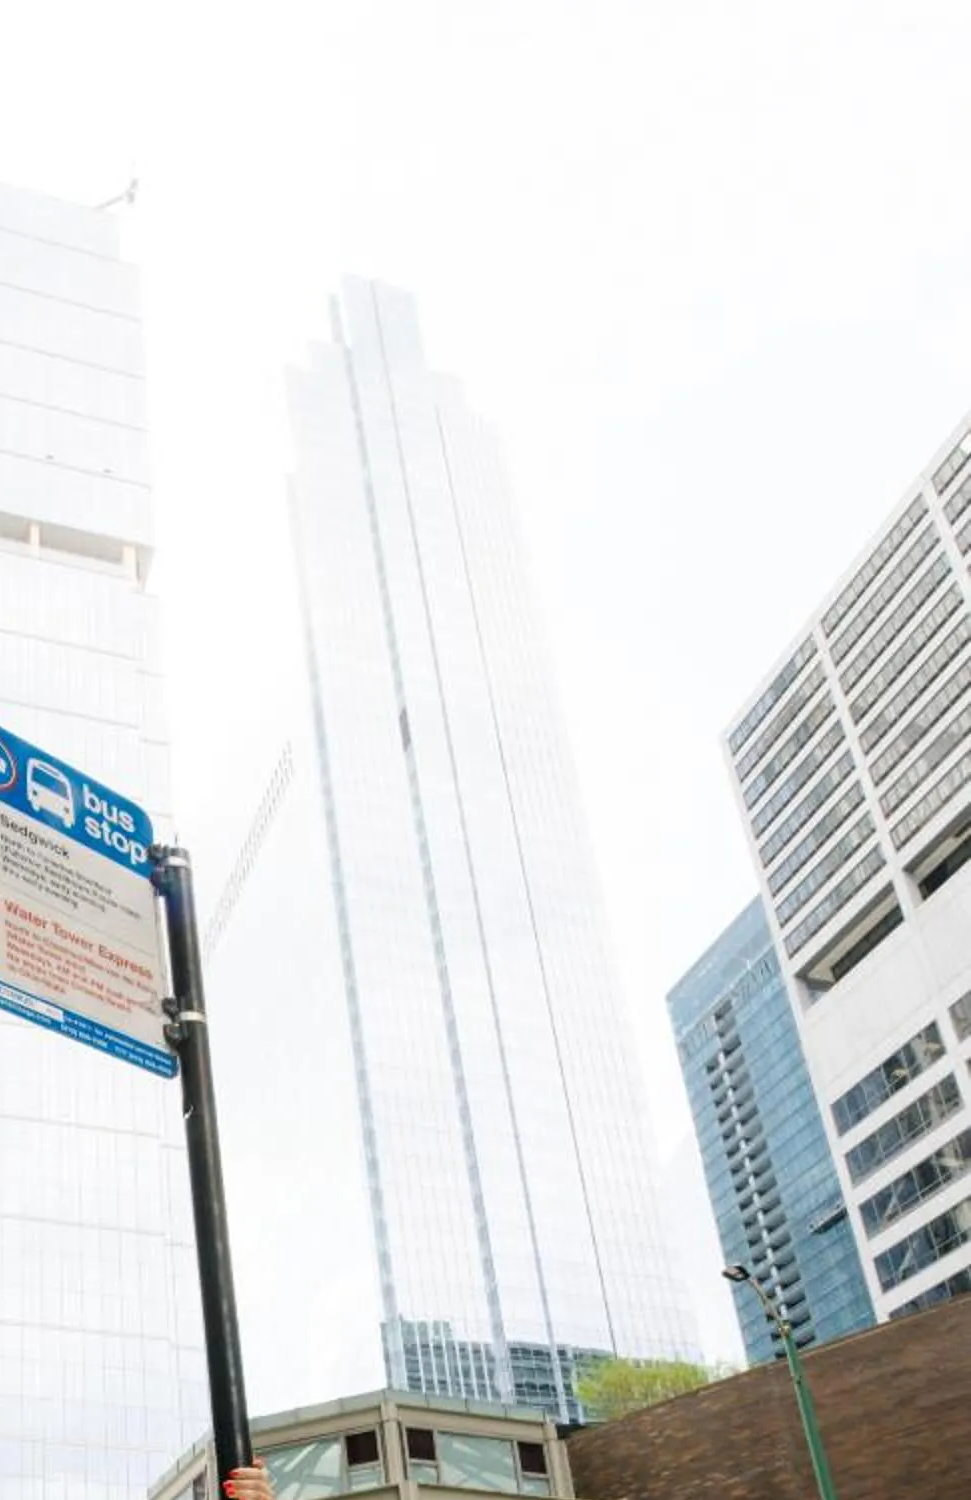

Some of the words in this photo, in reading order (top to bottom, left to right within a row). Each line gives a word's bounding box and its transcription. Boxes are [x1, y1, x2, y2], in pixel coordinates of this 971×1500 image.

[82, 783, 135, 833] bus
[0, 814, 70, 860] Sedgwick
[83, 816, 148, 865] stop
[4, 899, 49, 931] Water
[52, 921, 94, 951] Tower
[98, 943, 155, 980] Express
